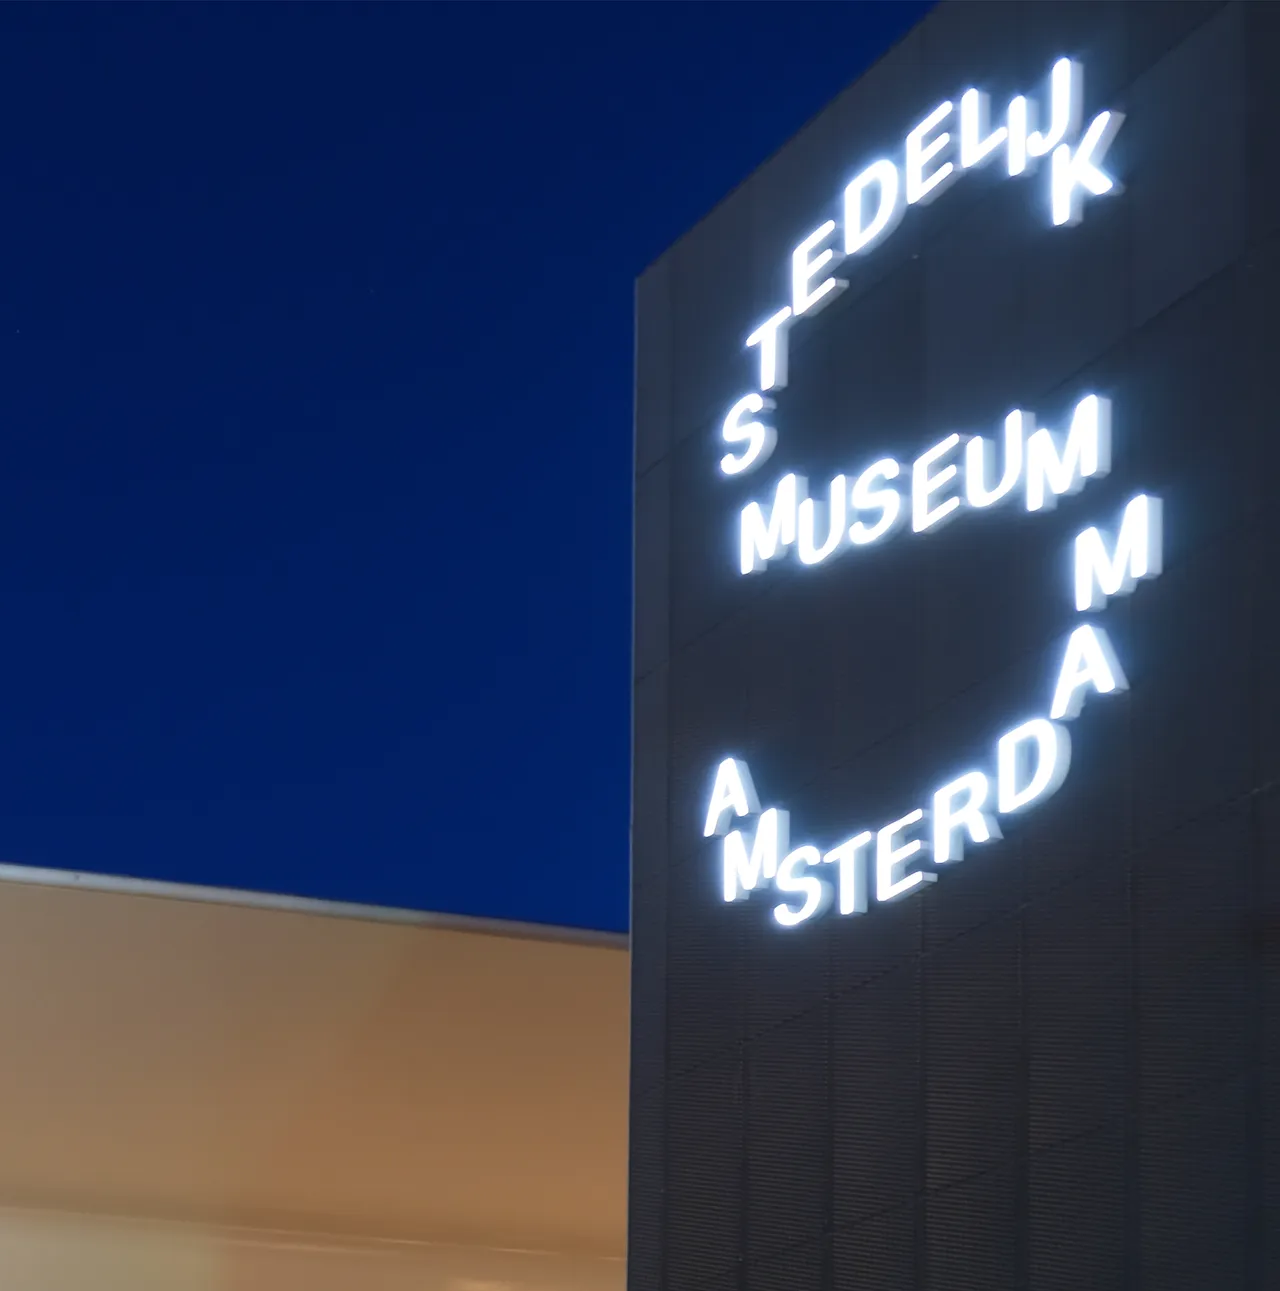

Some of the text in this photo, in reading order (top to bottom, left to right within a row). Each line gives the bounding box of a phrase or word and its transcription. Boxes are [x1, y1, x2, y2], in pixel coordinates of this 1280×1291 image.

[719, 55, 1126, 476] STEDELIJK
[739, 393, 1112, 576] MUSEUM
[703, 493, 1163, 927] AMSTERDAM
